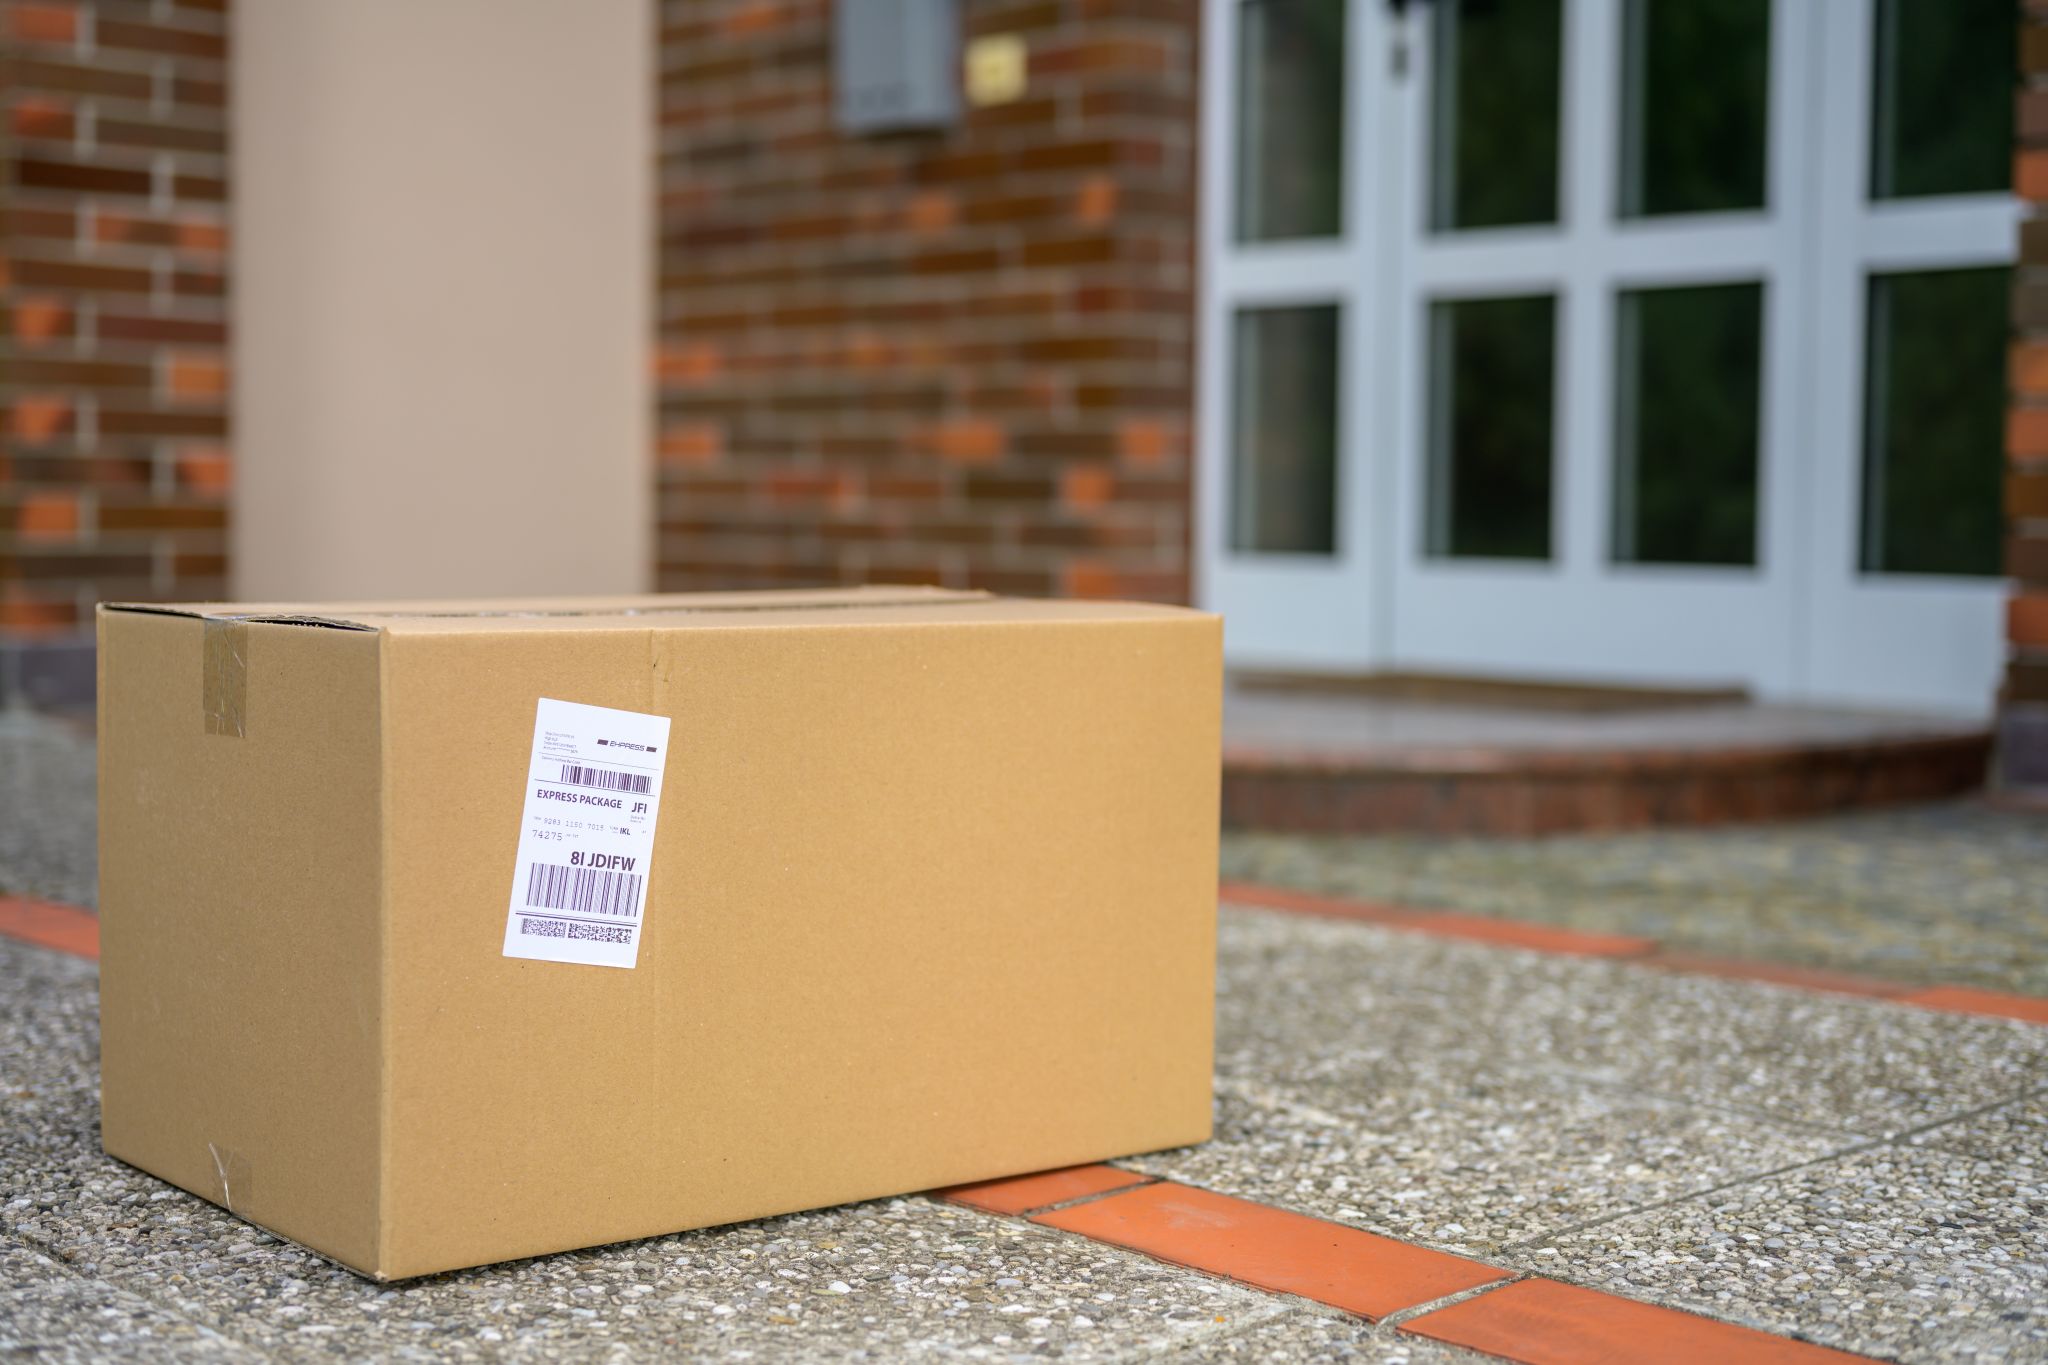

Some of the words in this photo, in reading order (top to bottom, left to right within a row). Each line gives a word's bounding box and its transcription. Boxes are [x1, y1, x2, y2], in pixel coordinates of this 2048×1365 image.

[537, 789, 578, 803] EXPRESS
[579, 794, 623, 809] PACKAGE
[631, 801, 648, 814] JFI
[532, 829, 563, 841] 74275
[619, 827, 631, 836] IKL
[587, 852, 636, 872] JDIFW
